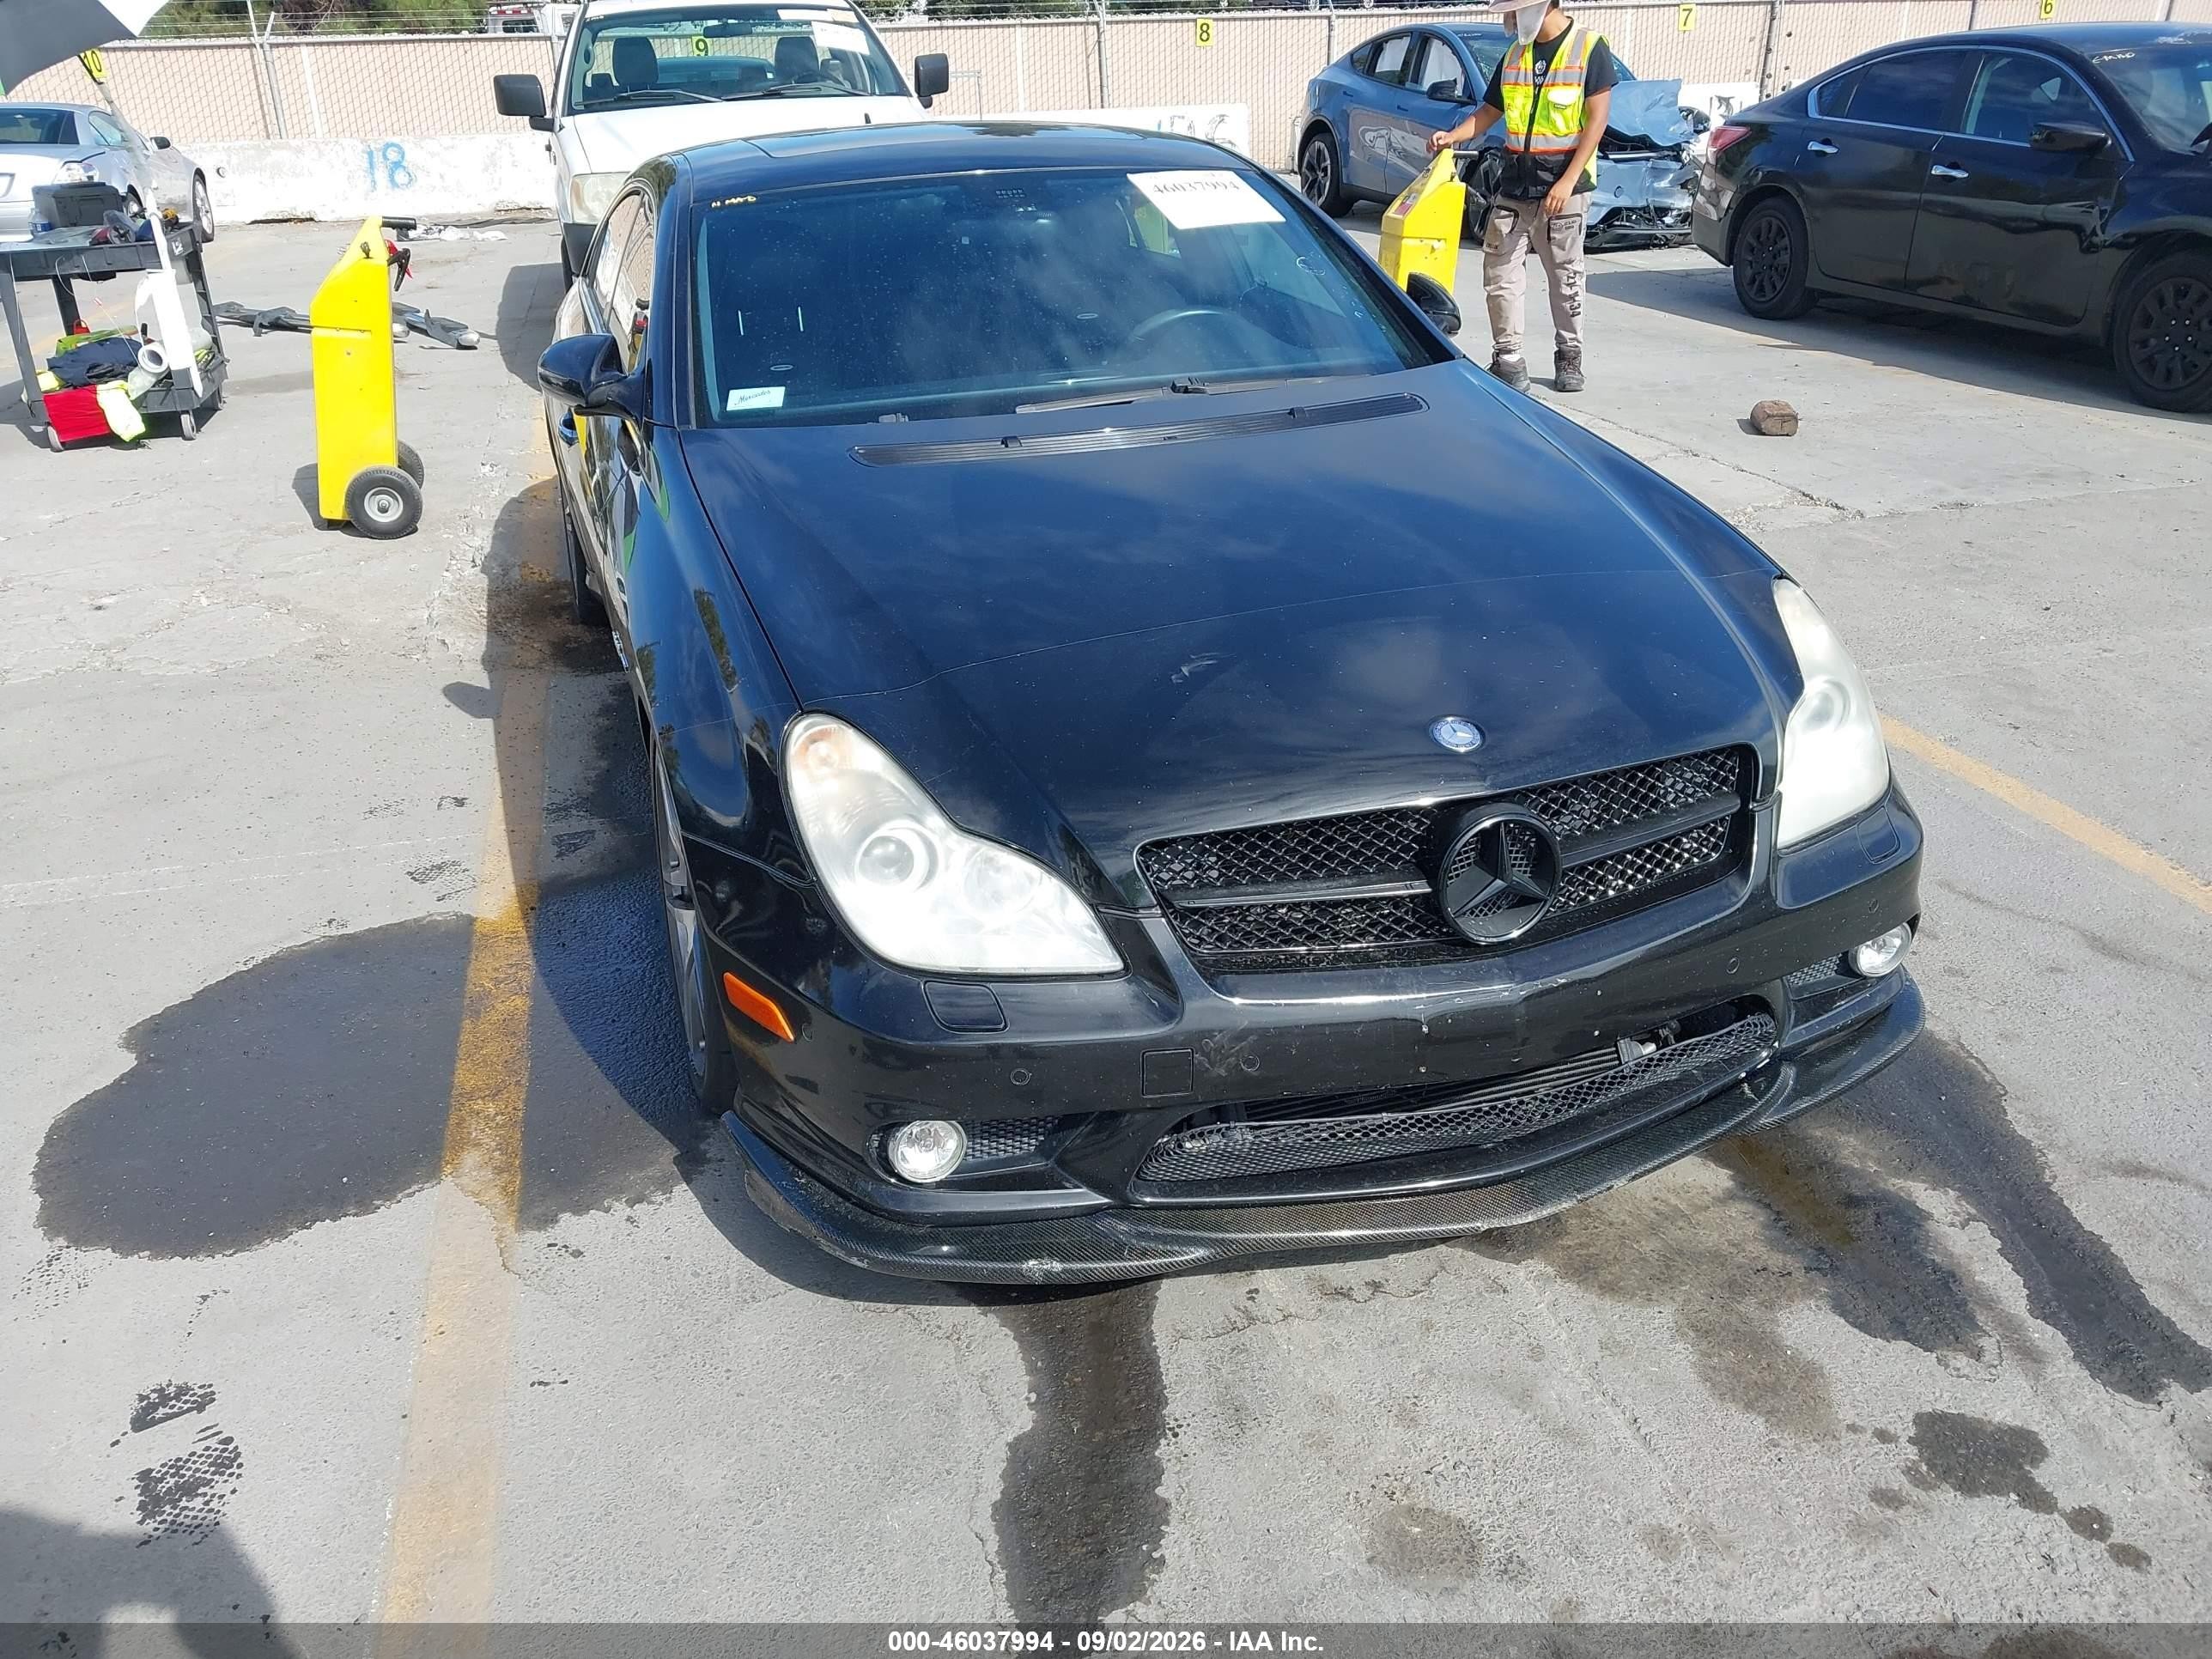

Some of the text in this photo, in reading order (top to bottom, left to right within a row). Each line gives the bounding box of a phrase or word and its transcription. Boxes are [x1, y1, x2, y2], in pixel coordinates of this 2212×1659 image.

[2044, 0, 2053, 14] 6
[1682, 8, 1692, 27] 7
[1200, 22, 1210, 42] 8
[695, 38, 708, 56] 9
[83, 49, 102, 73] 10
[367, 143, 412, 190] 18
